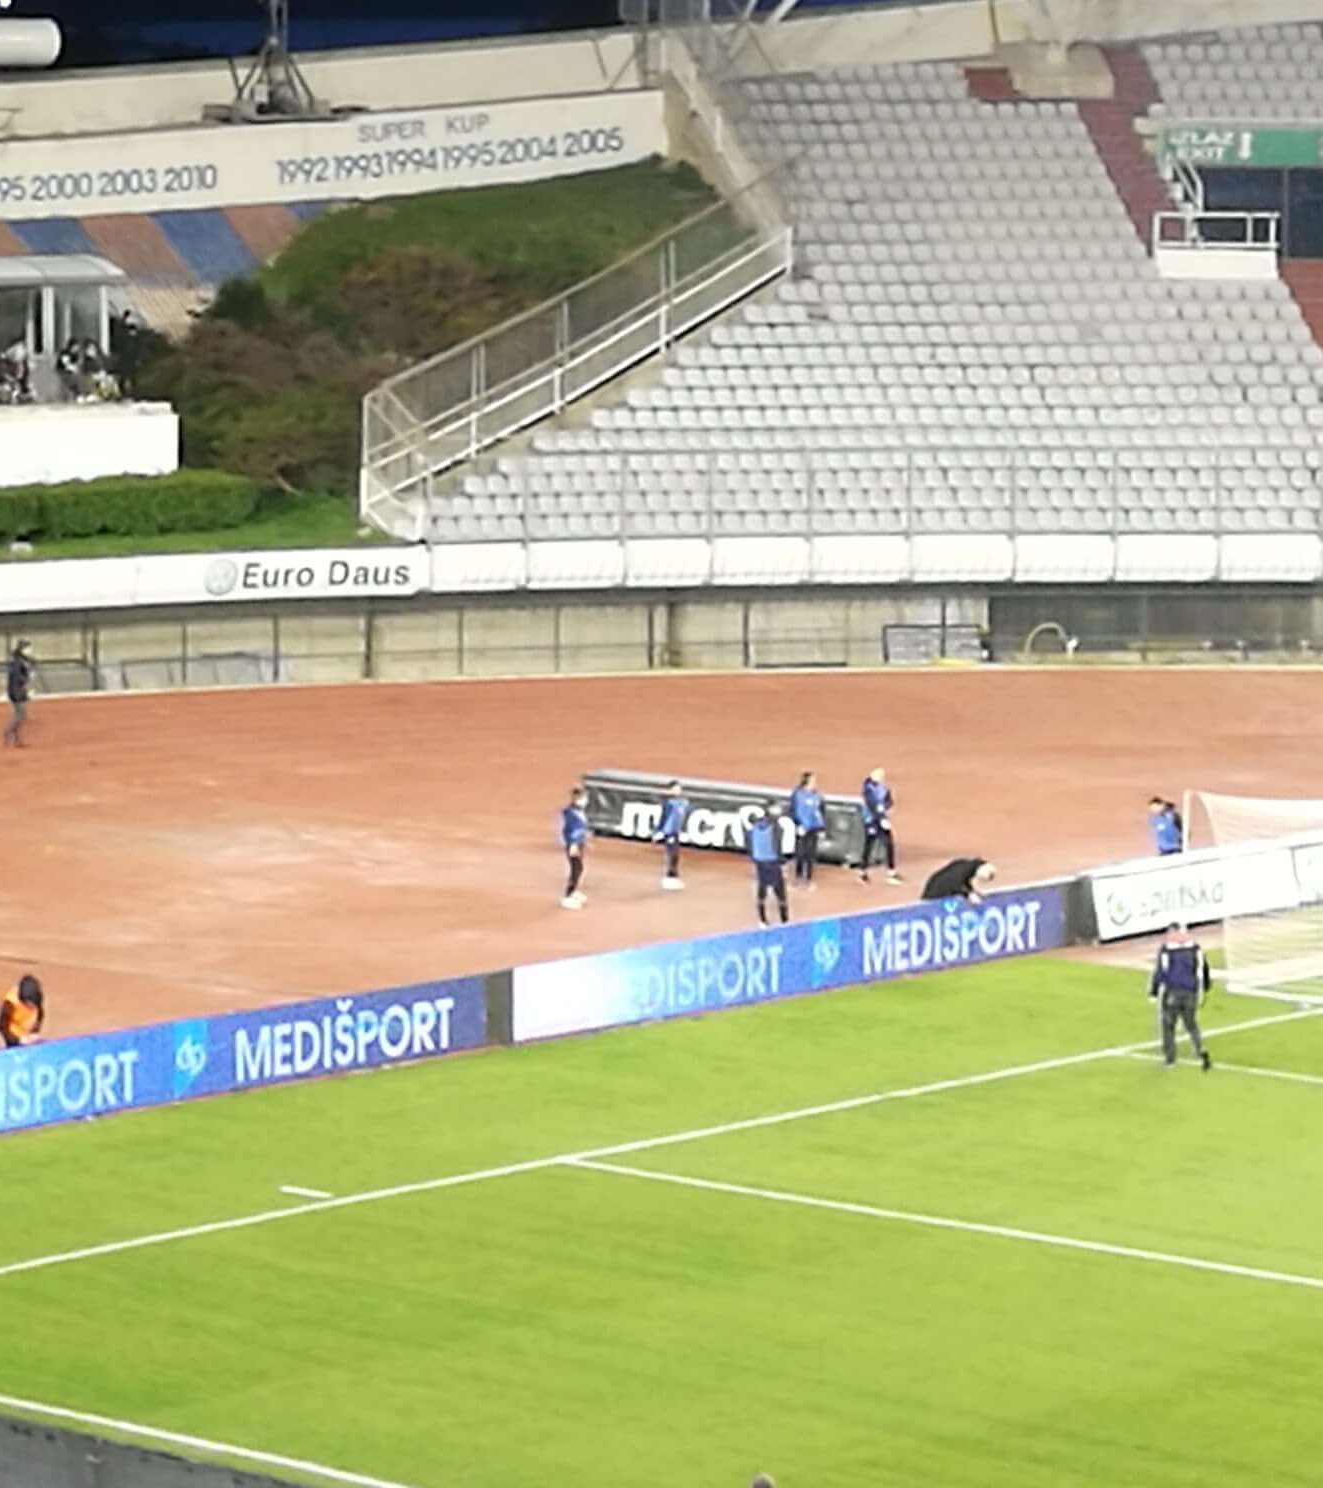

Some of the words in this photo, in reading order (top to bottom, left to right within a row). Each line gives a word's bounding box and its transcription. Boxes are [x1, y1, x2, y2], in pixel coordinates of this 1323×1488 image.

[358, 120, 426, 144] SUPER
[445, 114, 491, 134] KUP
[276, 158, 328, 184] 1992
[334, 154, 385, 182] 1993
[442, 142, 495, 170] 1995
[498, 137, 557, 165] 2004
[563, 127, 625, 156] 2005
[31, 172, 94, 201] 2000
[98, 168, 158, 197] 2003
[163, 164, 218, 192] 2010
[241, 561, 316, 589] Euro
[328, 559, 411, 587] Daus
[862, 897, 1040, 976] MEDIŠPORT
[235, 998, 454, 1084] MEDIŠPORT
